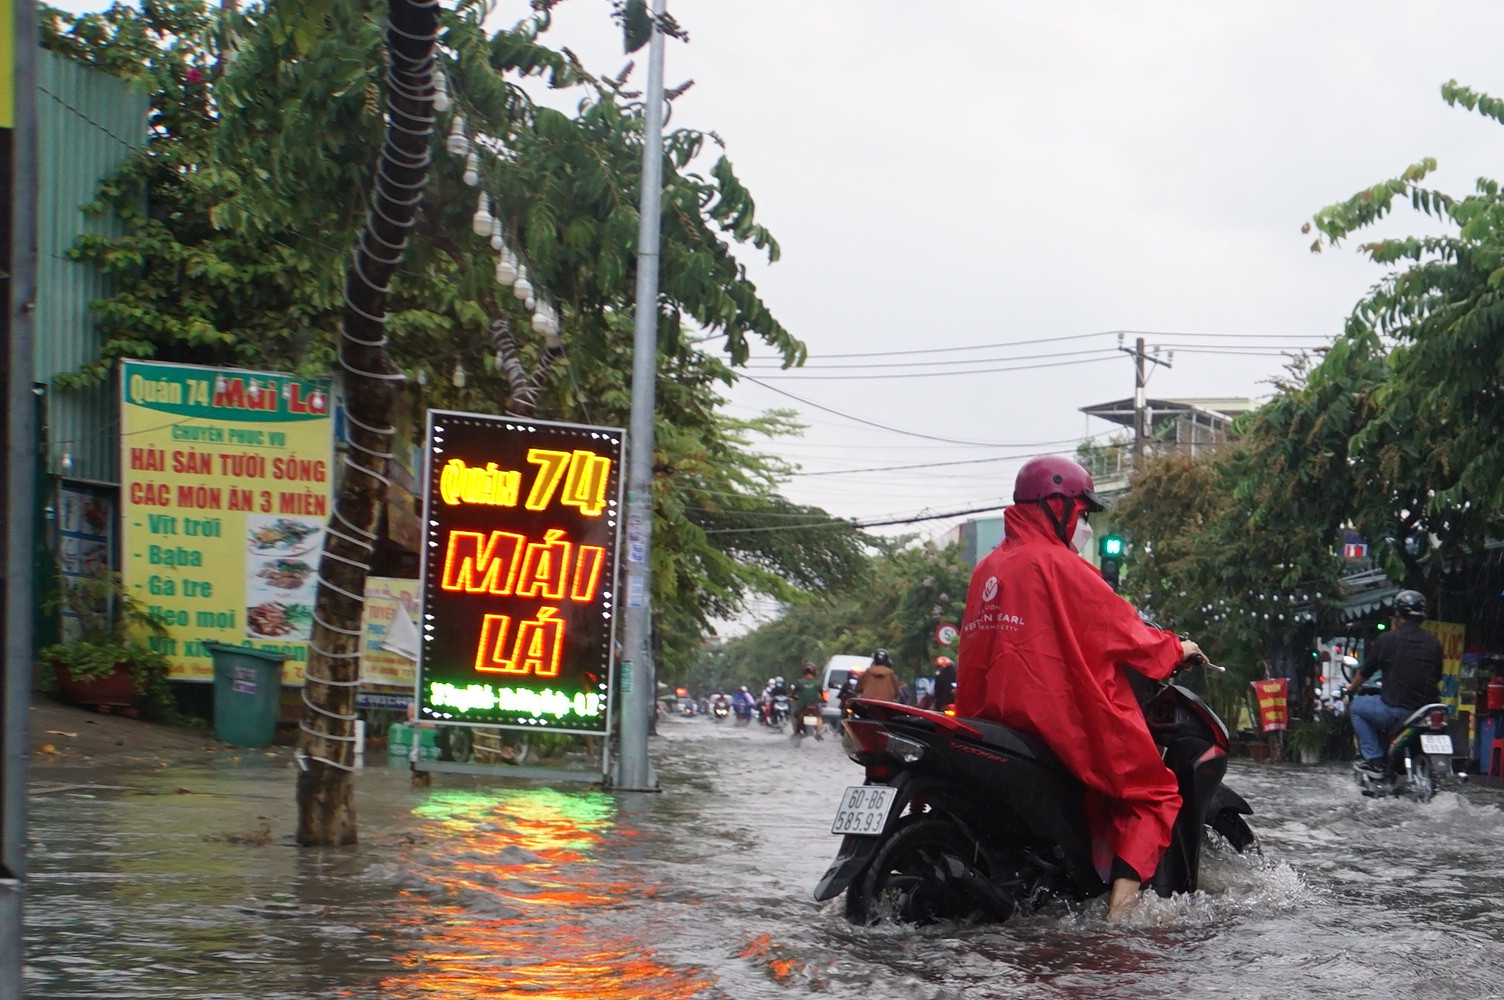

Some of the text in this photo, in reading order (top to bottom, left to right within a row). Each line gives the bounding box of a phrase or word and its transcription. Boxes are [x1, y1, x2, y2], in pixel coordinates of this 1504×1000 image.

[129, 374, 182, 404] Quán
[186, 378, 210, 406] 74
[130, 443, 166, 472] HẢI
[172, 446, 212, 475] SẢN
[273, 451, 326, 483] SỐNG
[130, 480, 171, 507] CÁC
[177, 484, 222, 510] MÓN
[260, 491, 272, 513] 3
[279, 488, 326, 517] MIỀN
[440, 448, 612, 516] Quán 74
[441, 528, 606, 602] MÁI
[148, 574, 213, 598] Gà tre
[474, 605, 567, 678] LÁ
[849, 789, 886, 809] 60-B6
[835, 811, 884, 832] 585.93
